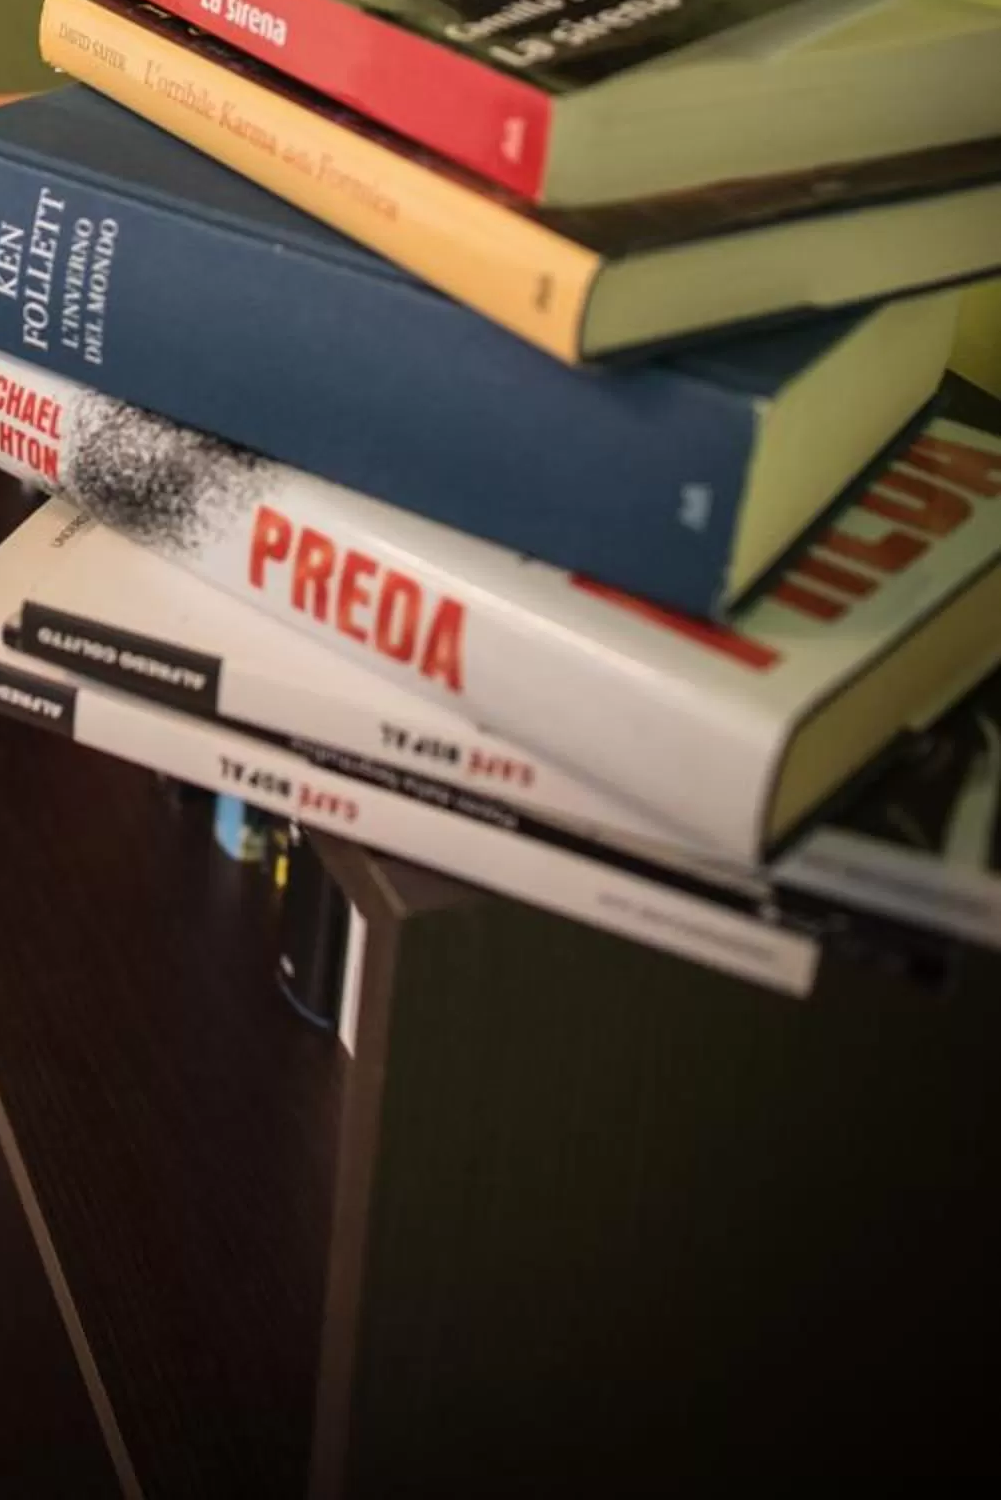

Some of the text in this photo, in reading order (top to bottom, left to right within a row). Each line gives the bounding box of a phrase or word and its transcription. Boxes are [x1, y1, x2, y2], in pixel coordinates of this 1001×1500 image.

[22, 186, 65, 350] FOLLETT
[61, 217, 94, 349] L'INVERNO
[83, 217, 119, 365] DEL MONDO
[37, 625, 207, 692] ALFREDO COLITTO
[248, 503, 469, 697] PREDA
